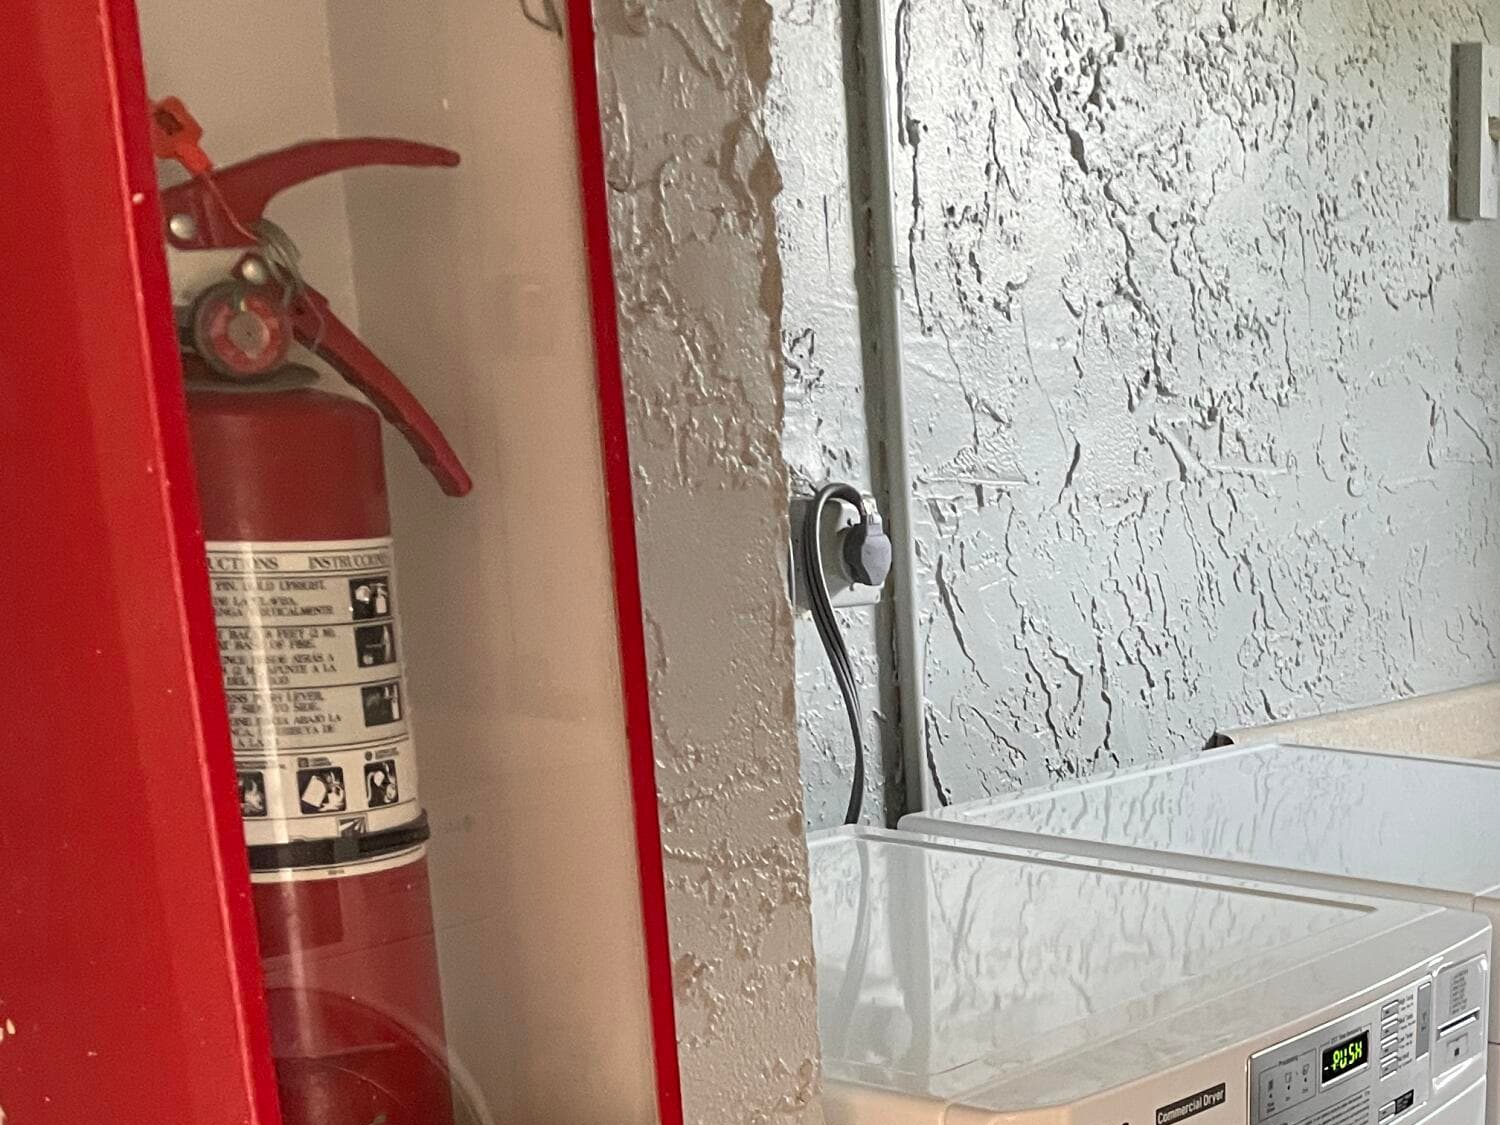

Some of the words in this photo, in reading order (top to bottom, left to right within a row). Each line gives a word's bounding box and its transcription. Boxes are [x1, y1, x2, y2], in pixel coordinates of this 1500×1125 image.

[1332, 1041, 1362, 1070] PUSH
[1157, 1098, 1202, 1124] Commercial
[1203, 1089, 1225, 1106] Dryer
